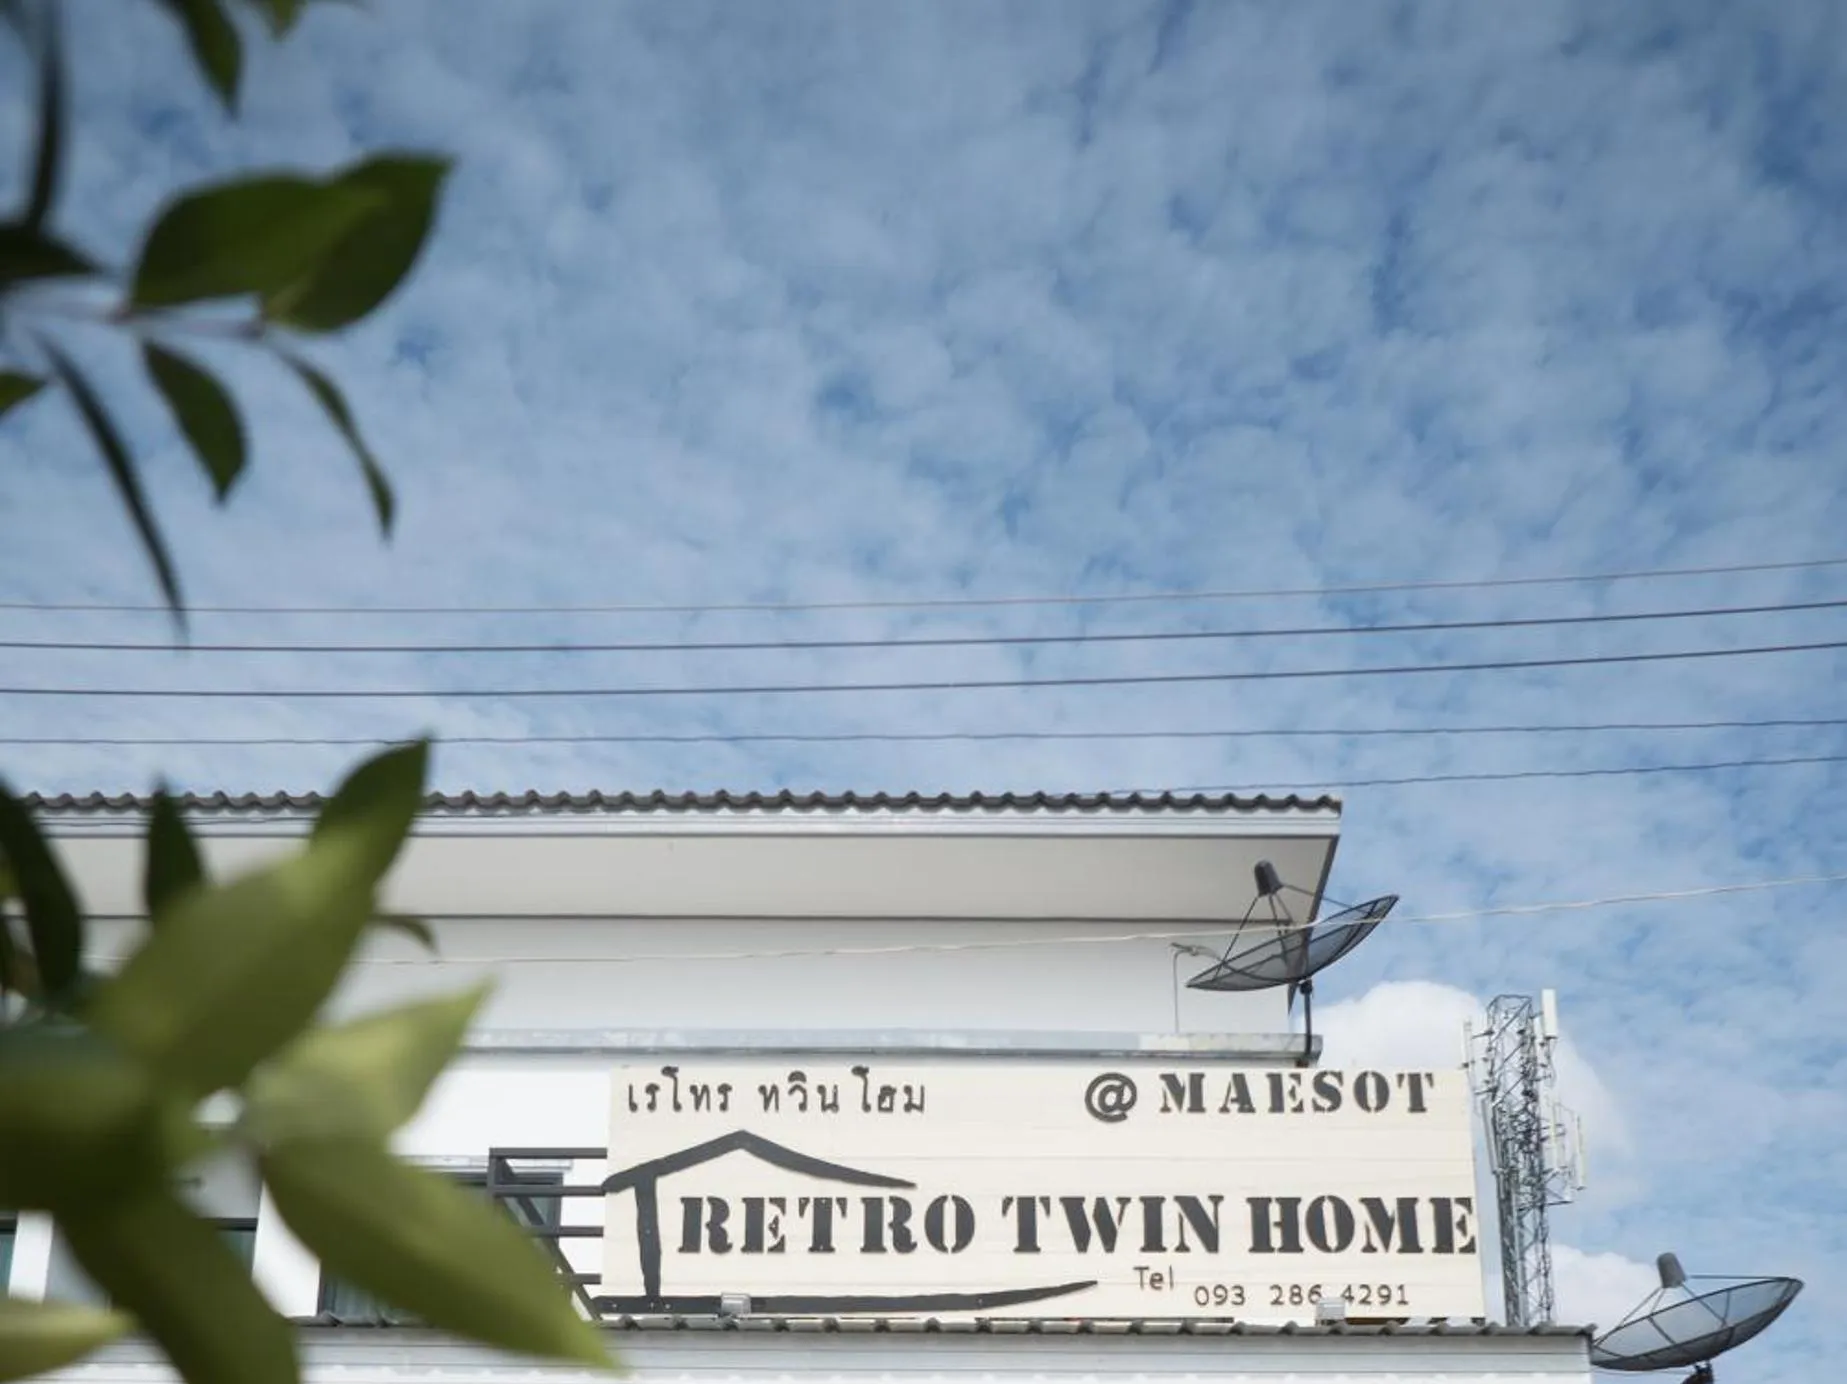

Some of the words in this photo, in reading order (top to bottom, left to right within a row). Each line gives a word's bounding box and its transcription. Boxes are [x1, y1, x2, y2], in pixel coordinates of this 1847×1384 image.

[1084, 1072, 1138, 1122] @
[1160, 1071, 1436, 1114] MAESOT
[677, 1194, 976, 1255] RETRO
[1001, 1194, 1225, 1255] TWIN
[1247, 1194, 1477, 1255] HOME
[1133, 1266, 1175, 1290] Tel
[1194, 1285, 1246, 1306] 093
[1270, 1284, 1322, 1306] 286
[1341, 1284, 1409, 1306] 4291
